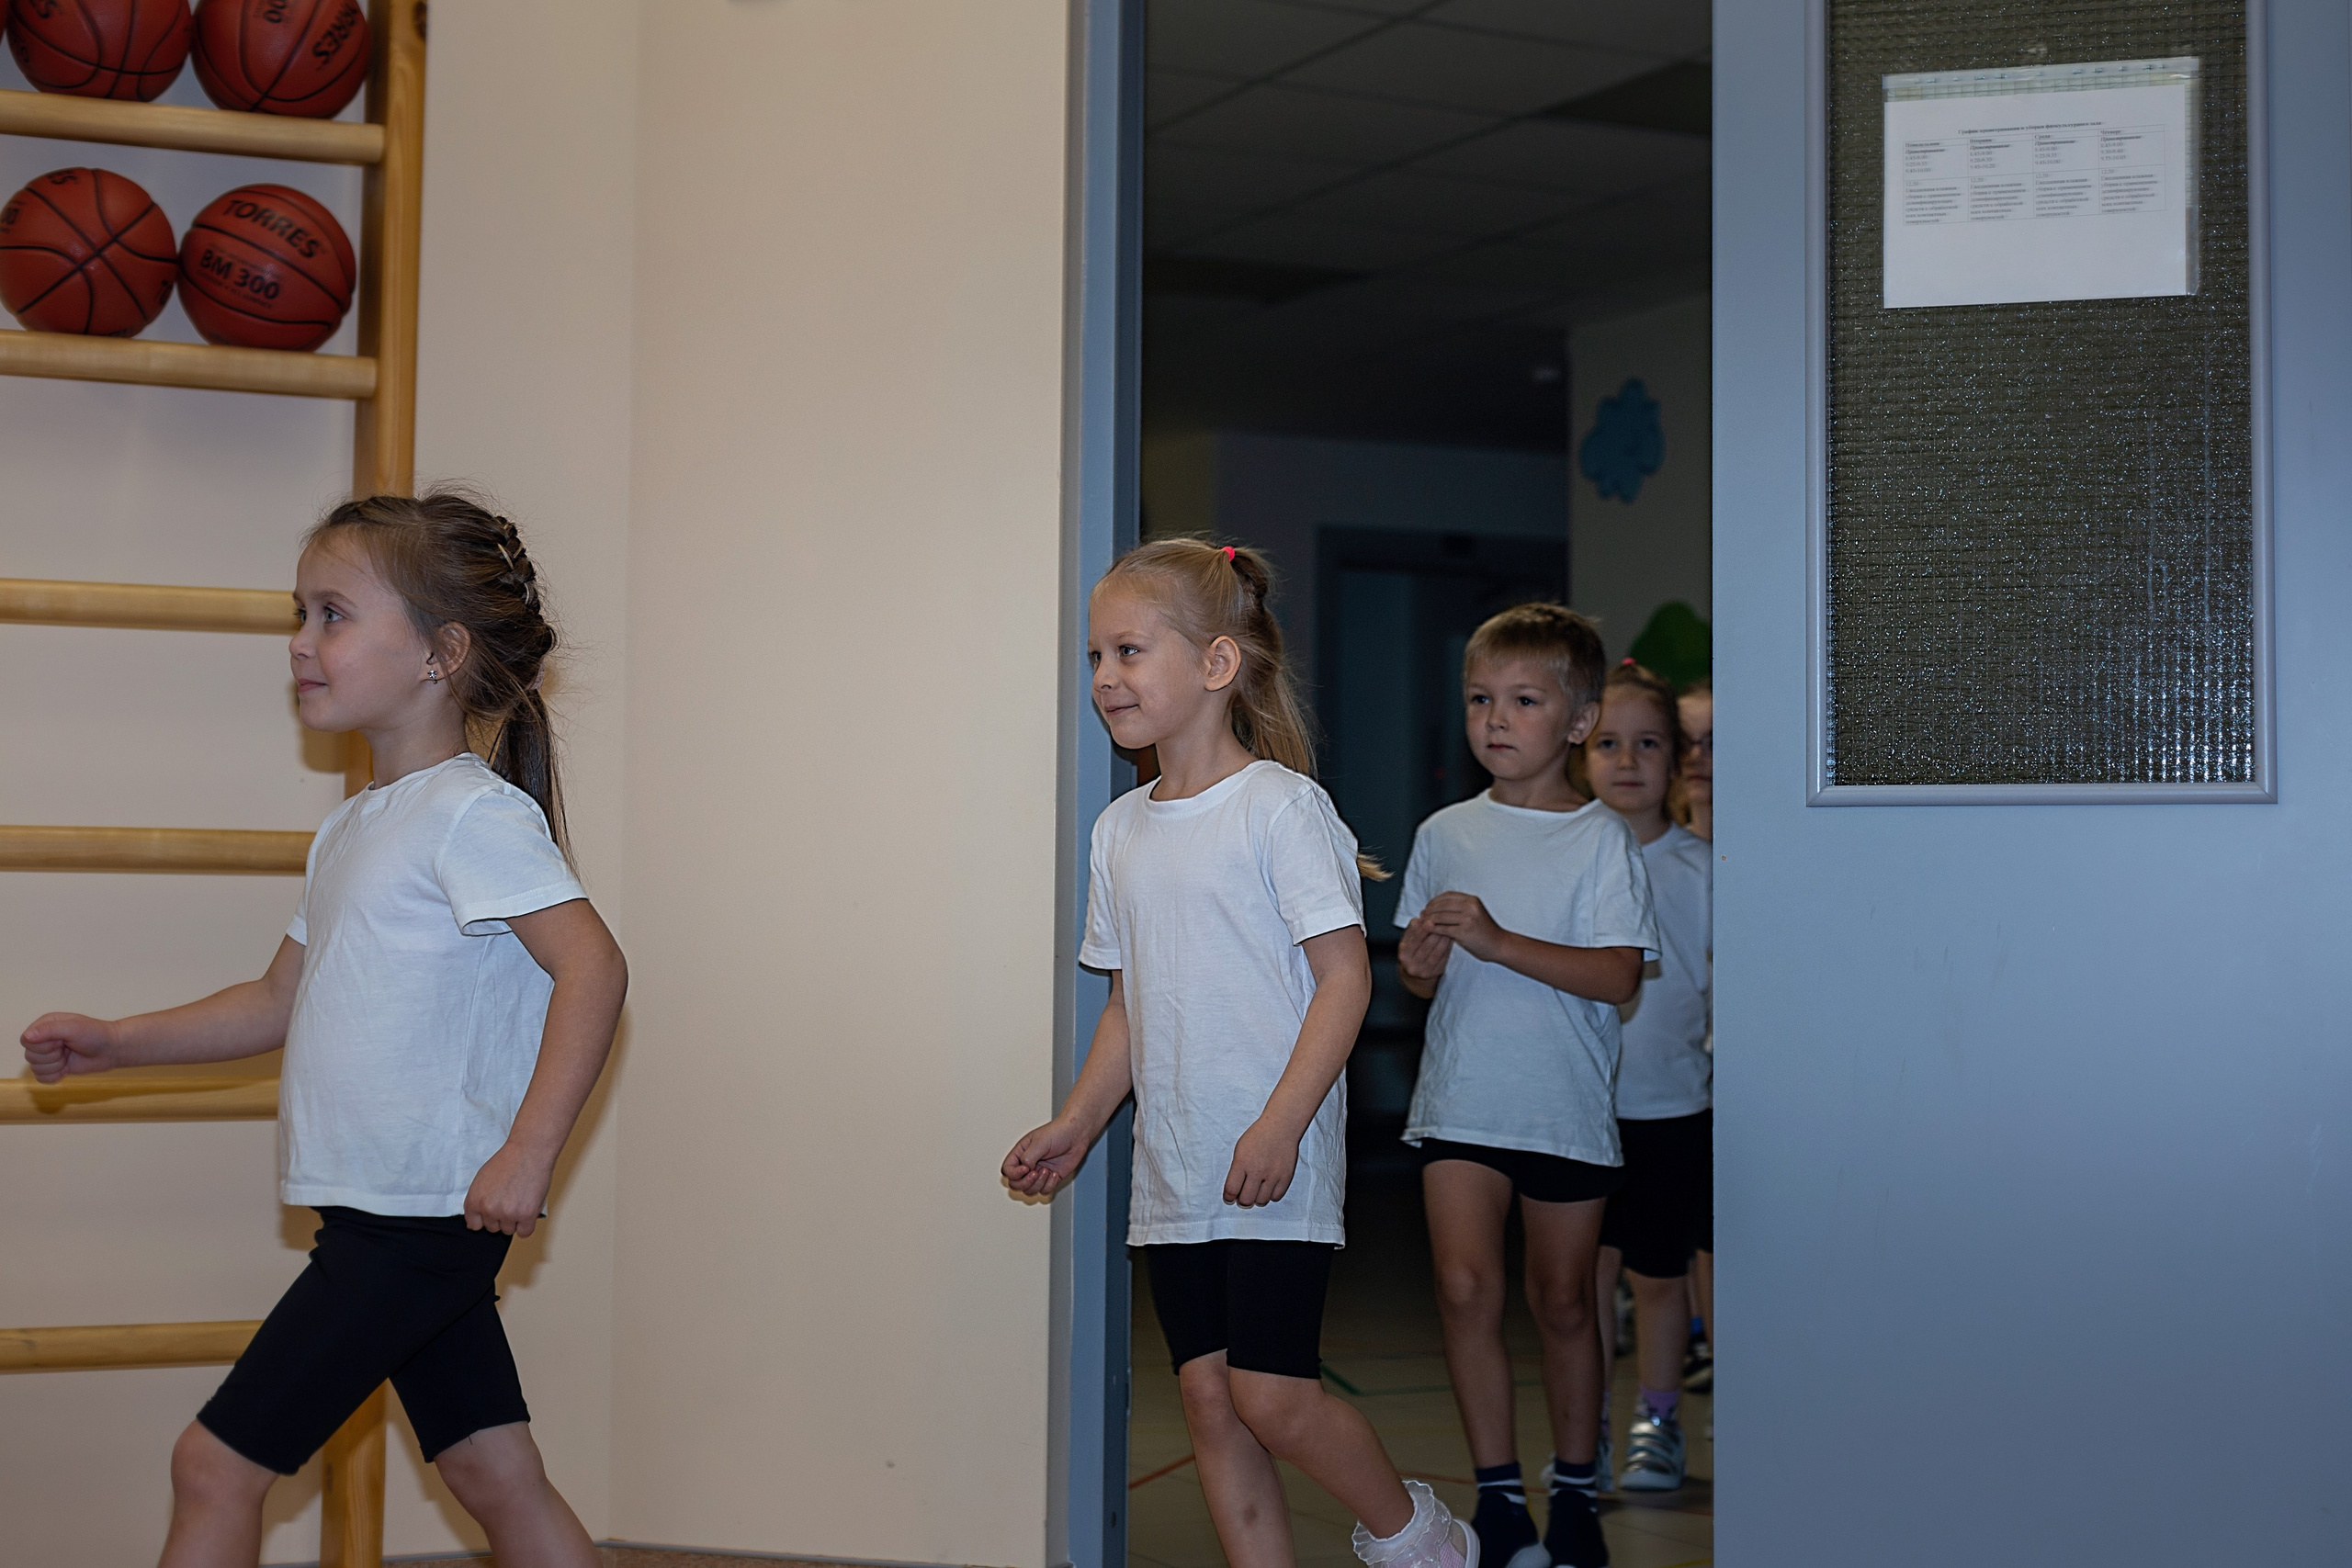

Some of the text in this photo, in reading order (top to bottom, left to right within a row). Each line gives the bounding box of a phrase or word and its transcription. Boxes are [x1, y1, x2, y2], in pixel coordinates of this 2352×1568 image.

[223, 199, 321, 259] TORRES
[199, 248, 233, 280] BM
[233, 267, 280, 299] 300
